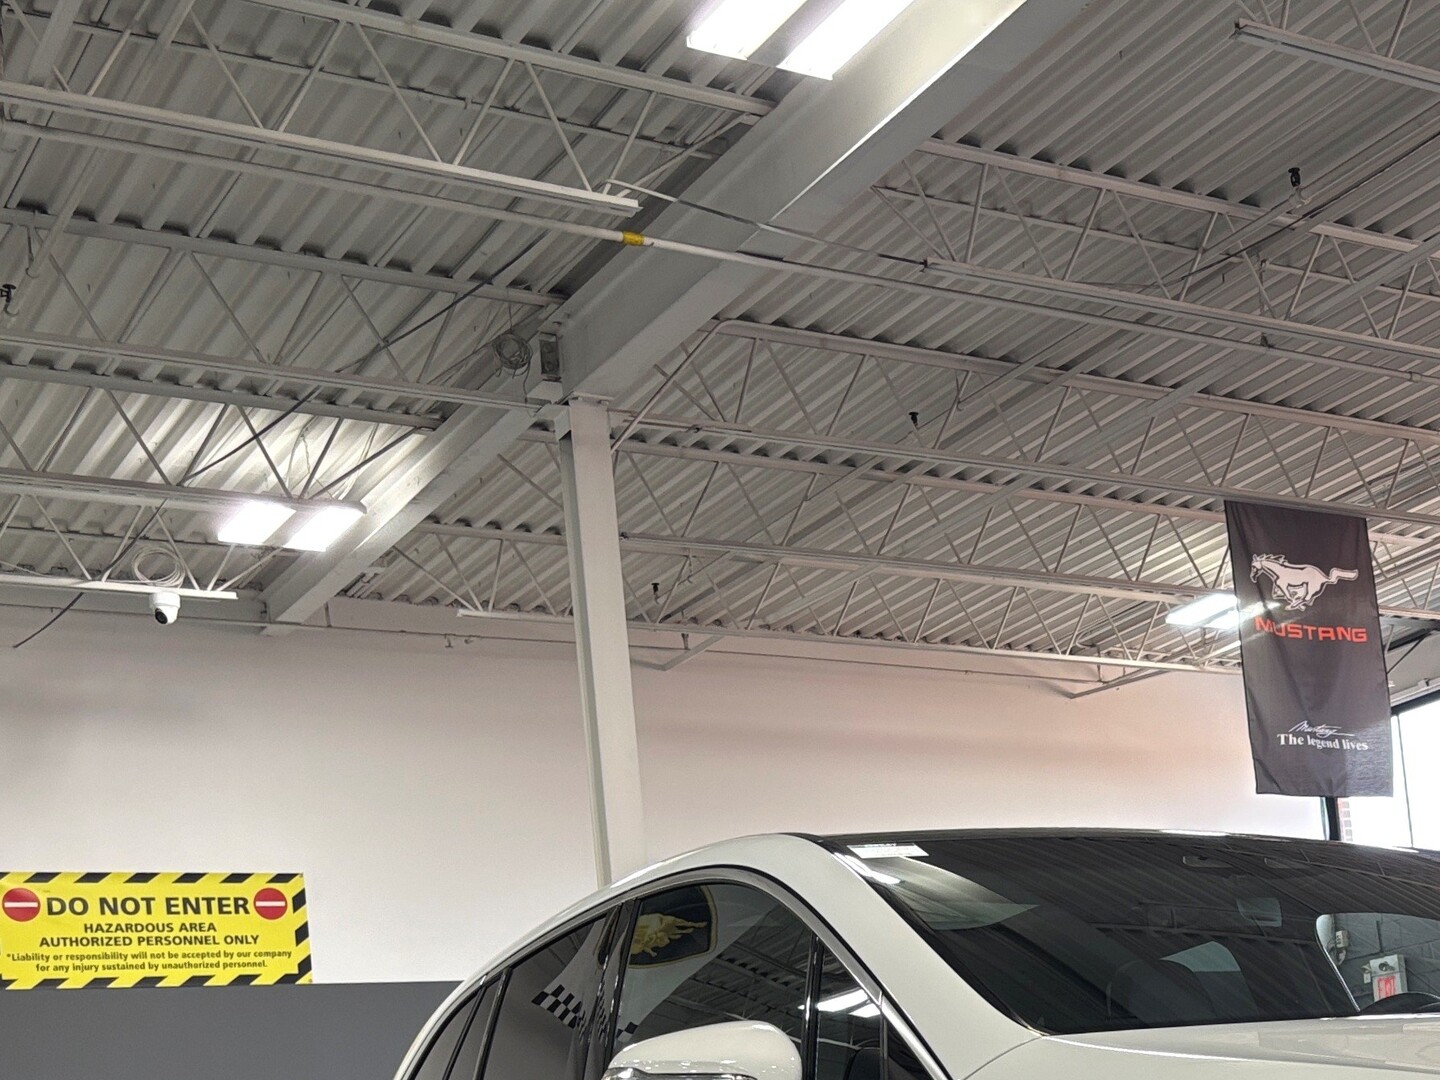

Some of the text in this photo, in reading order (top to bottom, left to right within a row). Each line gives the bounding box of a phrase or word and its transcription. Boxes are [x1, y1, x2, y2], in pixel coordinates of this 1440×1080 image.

[1255, 617, 1367, 642] MUSTANG
[1277, 734, 1370, 751] The legend lives
[46, 896, 250, 917] DO NOT ENTER
[83, 922, 217, 934] HAZARDOUS AREA
[39, 934, 259, 948] AUTHORIZED PERSONNEL ONLY
[52, 953, 63, 961] or
[65, 951, 128, 963] responsibility
[131, 951, 147, 960] will
[150, 951, 165, 959] not
[168, 950, 179, 959] be
[181, 950, 221, 960] accepted
[223, 950, 234, 960] by
[254, 950, 292, 960] company
[36, 963, 50, 972] for
[53, 964, 69, 973] any
[72, 963, 101, 973] injury
[102, 961, 146, 971] sustained
[148, 961, 159, 971] by
[162, 960, 221, 970] unauthorized
